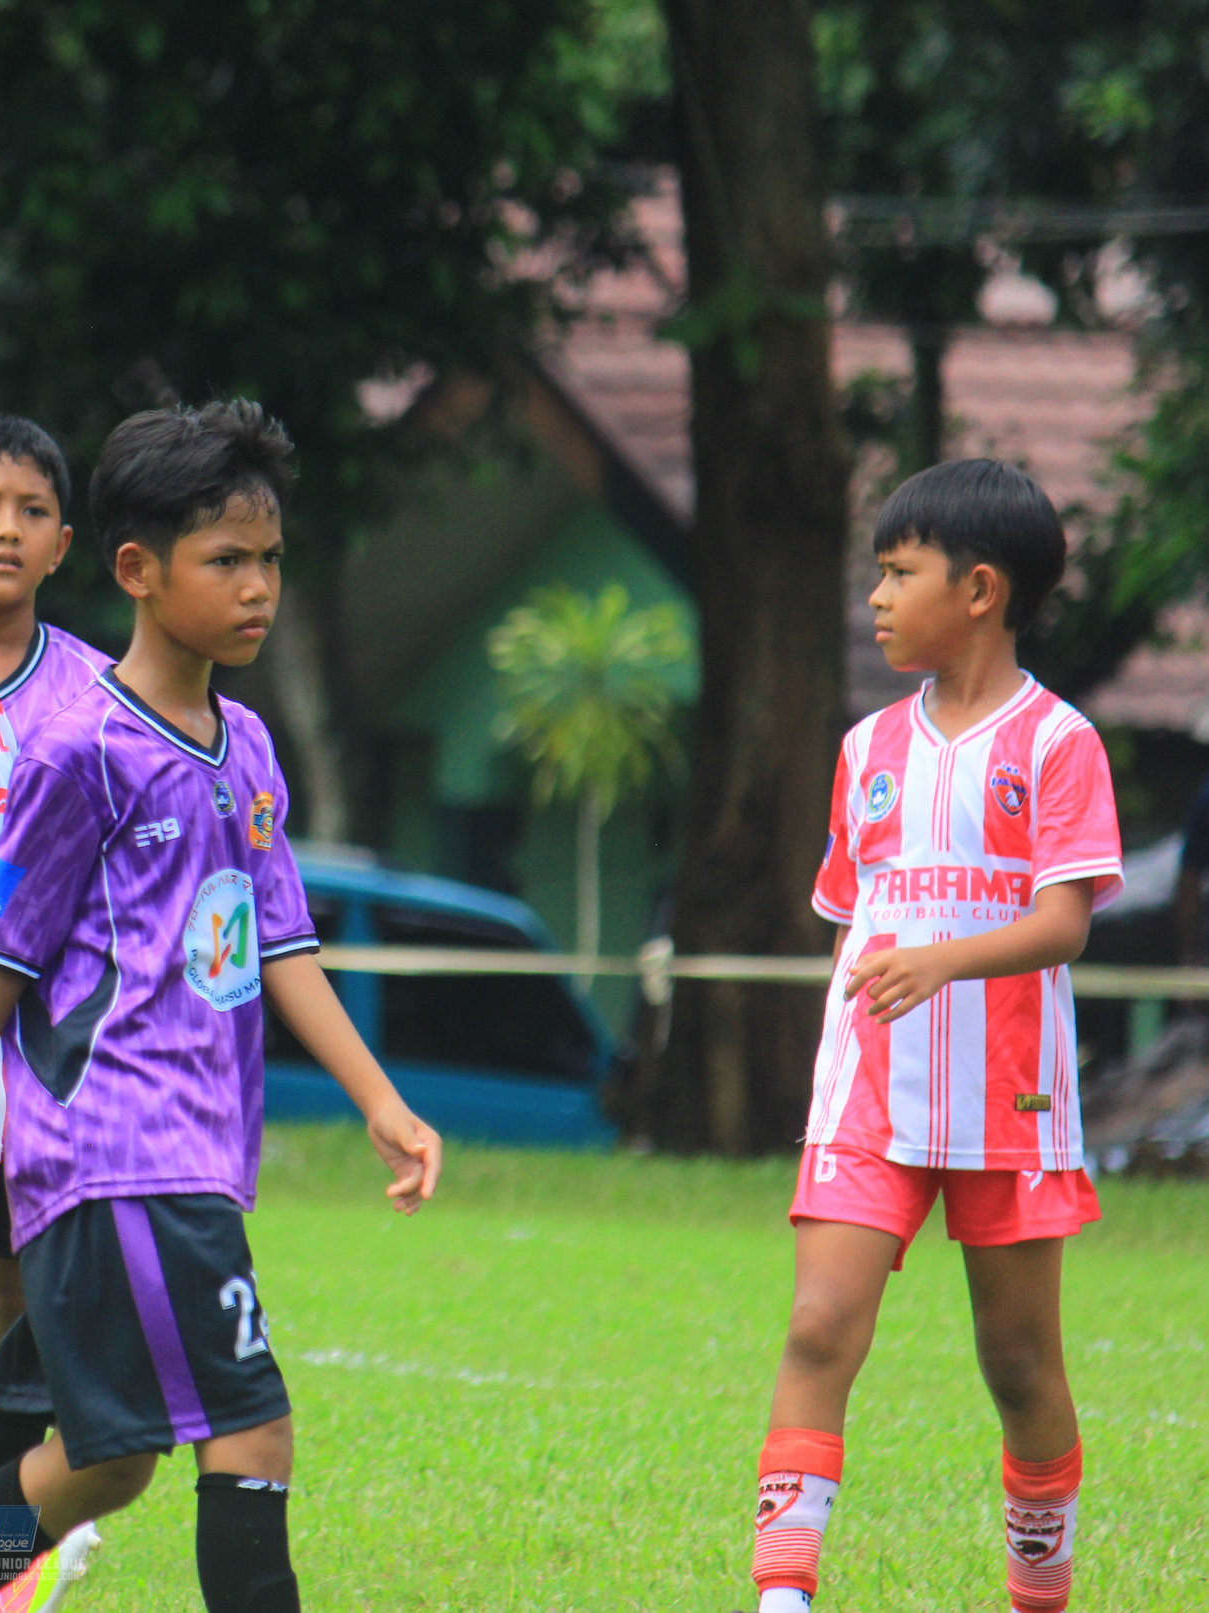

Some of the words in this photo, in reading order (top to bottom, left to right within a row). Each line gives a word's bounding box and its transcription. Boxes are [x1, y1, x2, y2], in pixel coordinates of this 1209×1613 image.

[867, 865, 1032, 908] FARAMA
[873, 906, 961, 922] FOOTBALL
[972, 906, 1022, 923] CLUB
[220, 1272, 270, 1363] 2
